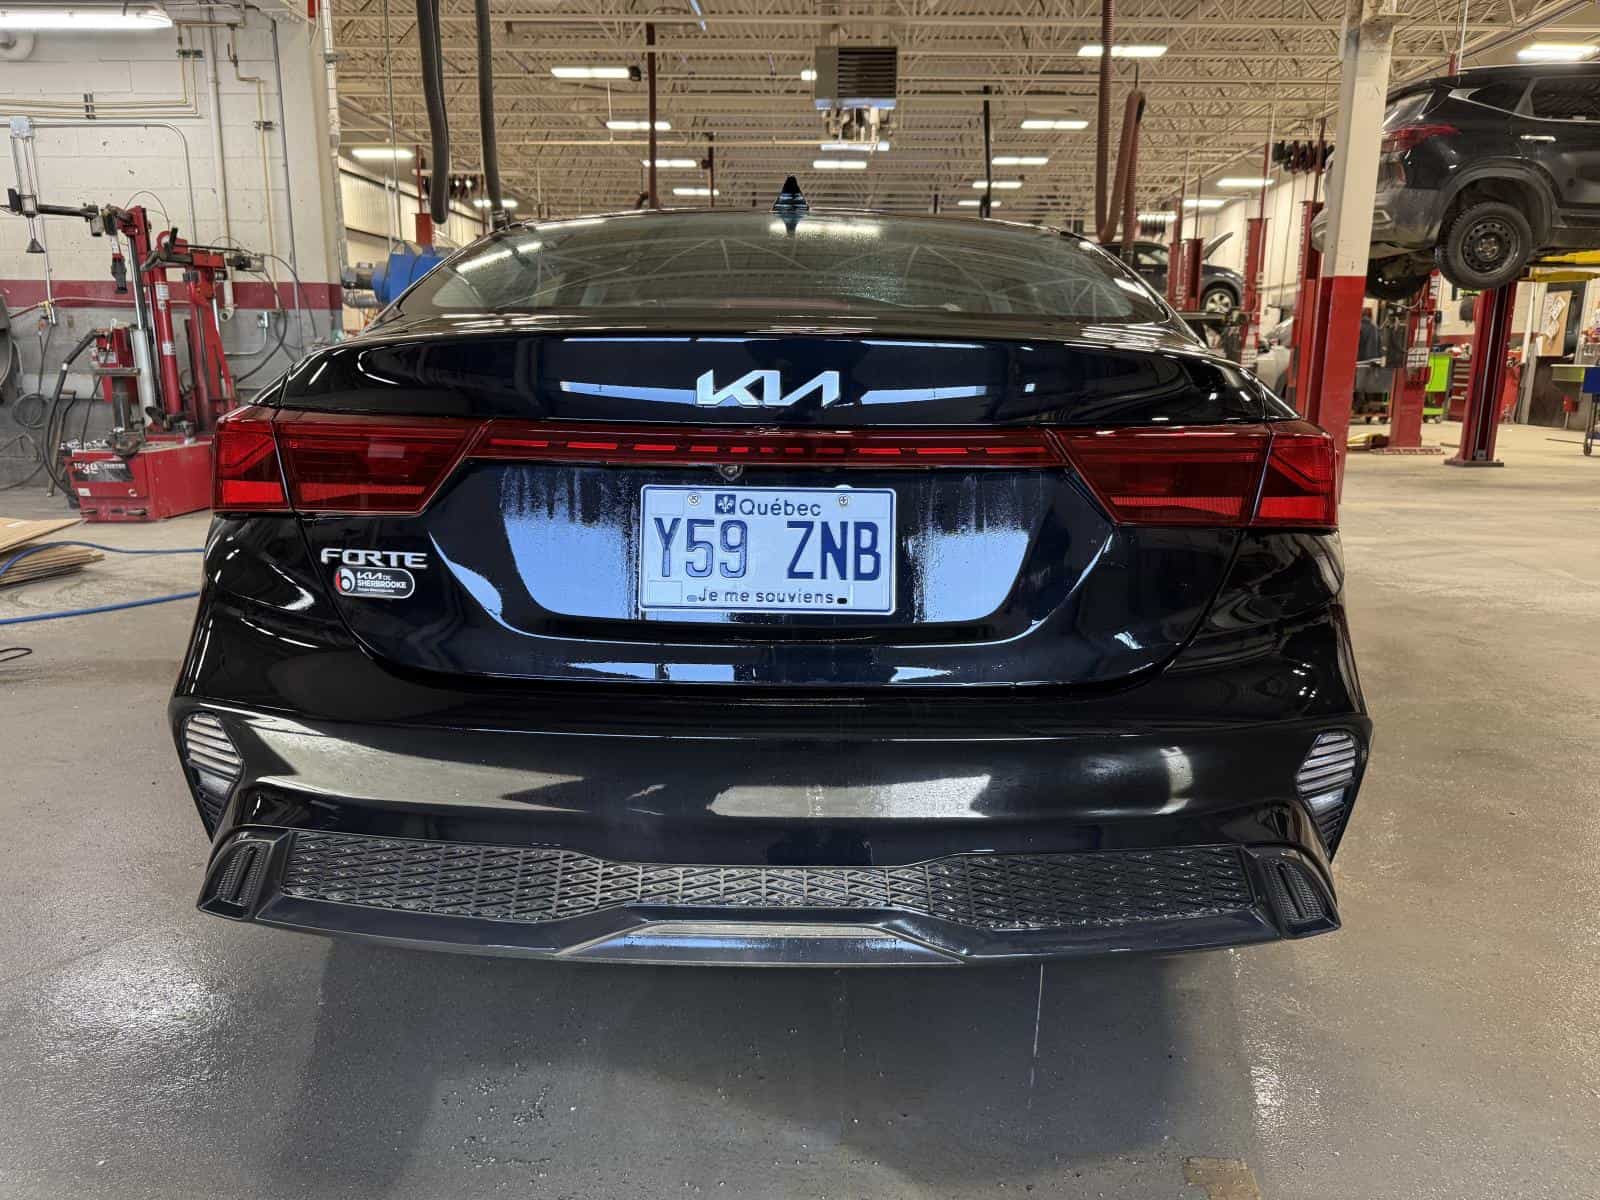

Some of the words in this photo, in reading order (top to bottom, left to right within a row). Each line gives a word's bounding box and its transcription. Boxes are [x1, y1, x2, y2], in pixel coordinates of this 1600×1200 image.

[696, 368, 840, 407] KIA
[739, 498, 822, 517] Québec
[320, 548, 428, 569] FORTE
[654, 517, 748, 578] Y59
[786, 520, 881, 581] ZNB
[357, 579, 407, 589] SHERBROOKE
[699, 588, 718, 602] Je
[724, 591, 750, 602] me
[756, 590, 834, 604] souviens
